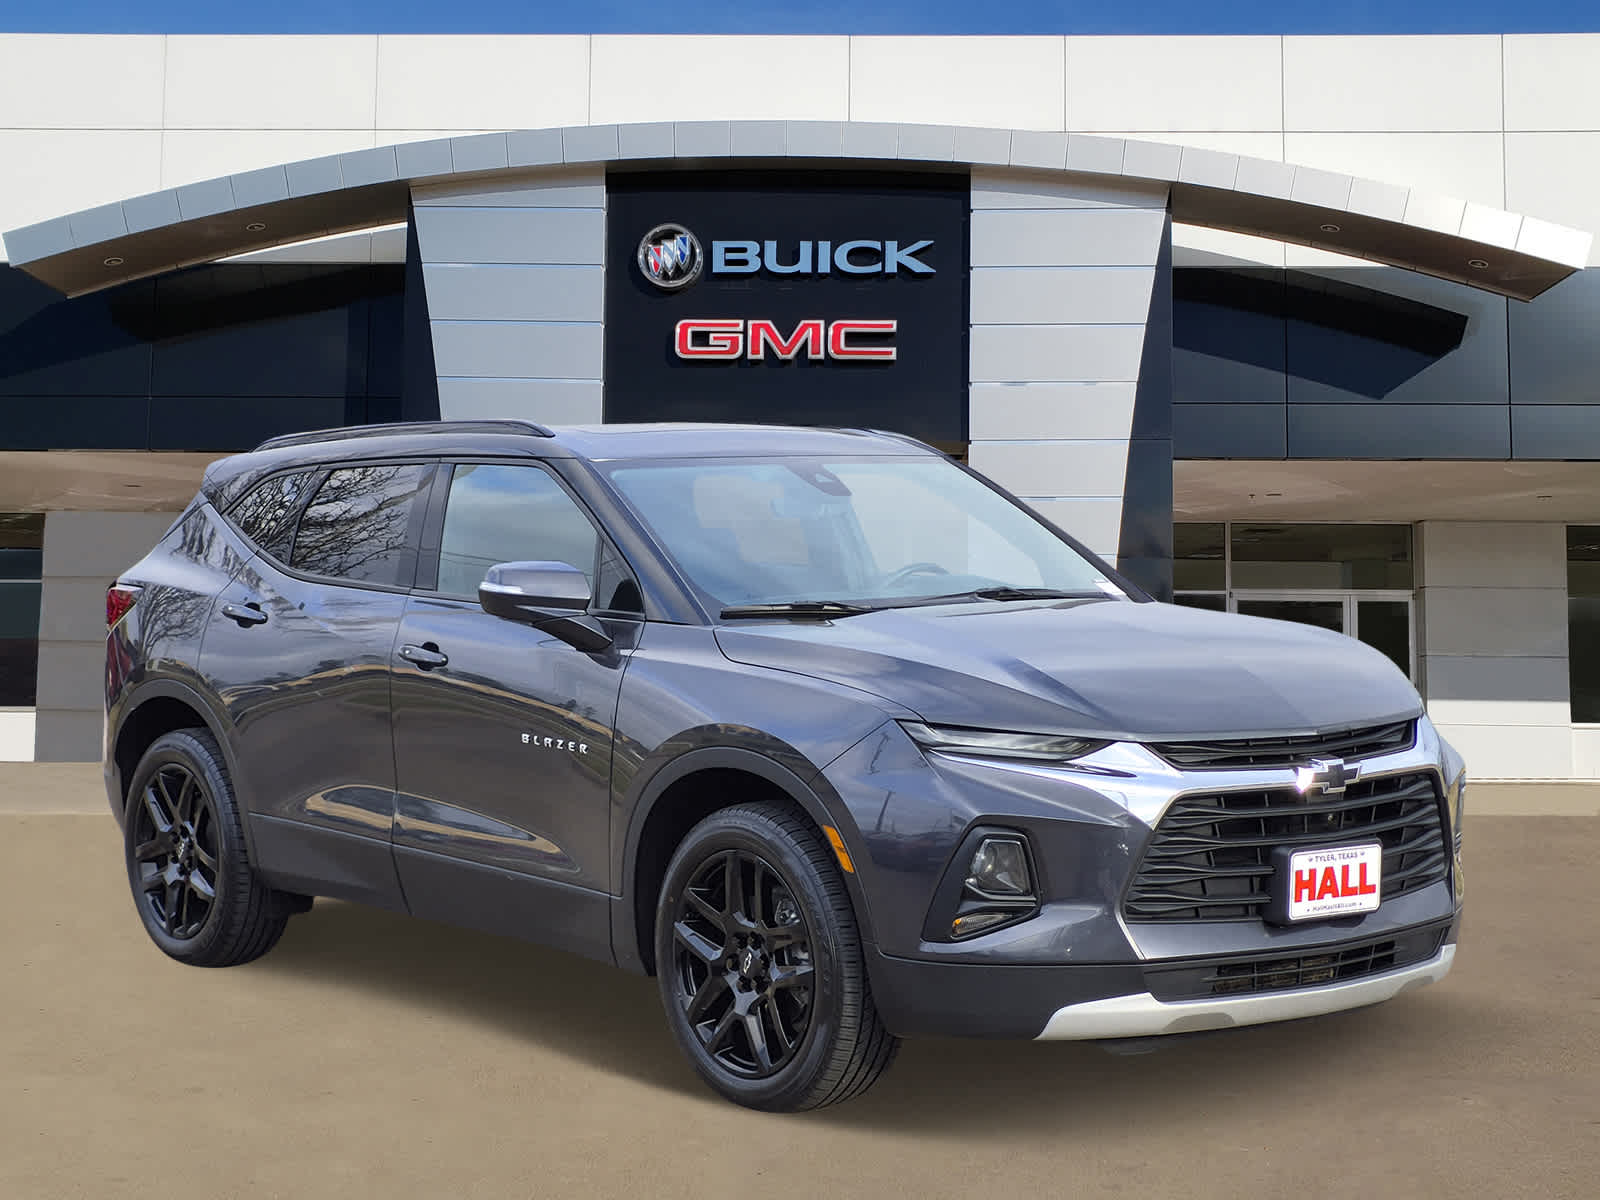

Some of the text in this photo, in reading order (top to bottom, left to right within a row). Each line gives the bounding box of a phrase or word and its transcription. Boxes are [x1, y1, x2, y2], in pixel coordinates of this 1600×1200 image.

[712, 240, 936, 273] BUICK
[675, 319, 897, 360] GMC
[521, 733, 588, 754] BLAZER
[1315, 852, 1358, 862] TYLER, TEXAS
[1294, 862, 1376, 903] HALL
